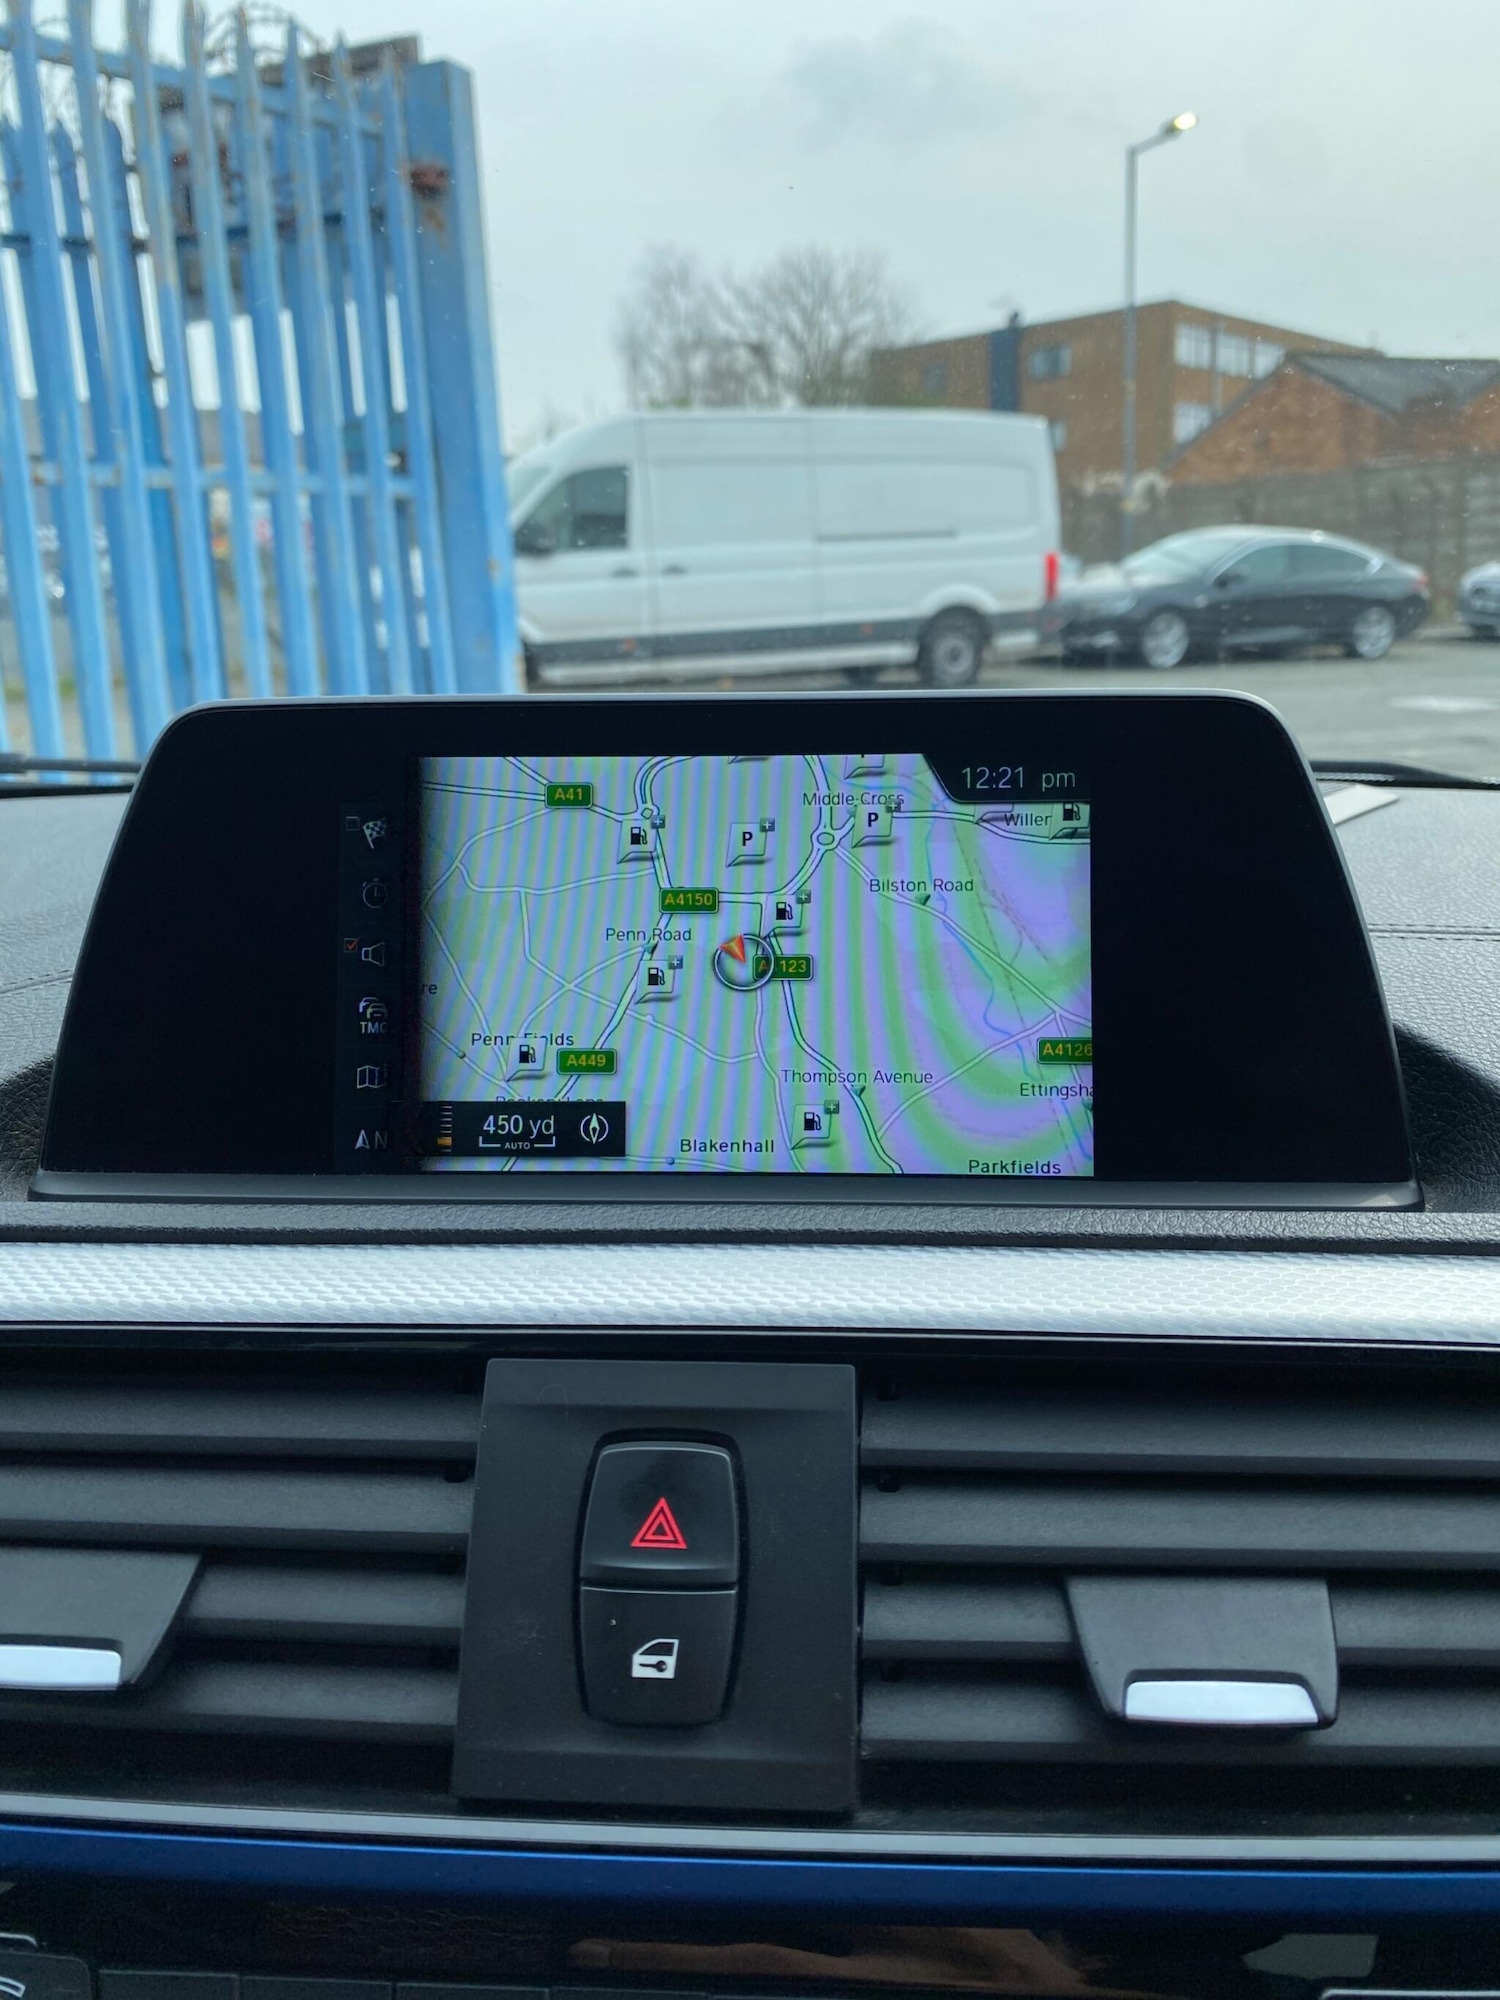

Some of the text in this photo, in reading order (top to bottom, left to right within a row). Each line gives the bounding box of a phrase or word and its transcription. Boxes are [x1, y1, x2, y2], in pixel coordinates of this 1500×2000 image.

[961, 767, 1077, 792] 12:21 pm
[553, 787, 585, 802] A41
[869, 878, 975, 893] Bilston Road
[663, 892, 714, 907] A4150
[605, 927, 692, 942] Penn Road
[758, 959, 807, 973] A123
[1042, 1043, 1093, 1057] A4126
[566, 1053, 607, 1067] A449
[781, 1069, 933, 1086] Thompson Avenue
[482, 1114, 555, 1139] 450 yd
[504, 1141, 531, 1150] AUTO
[680, 1139, 774, 1153] Blakenhall
[968, 1159, 1062, 1174] Parkfields
